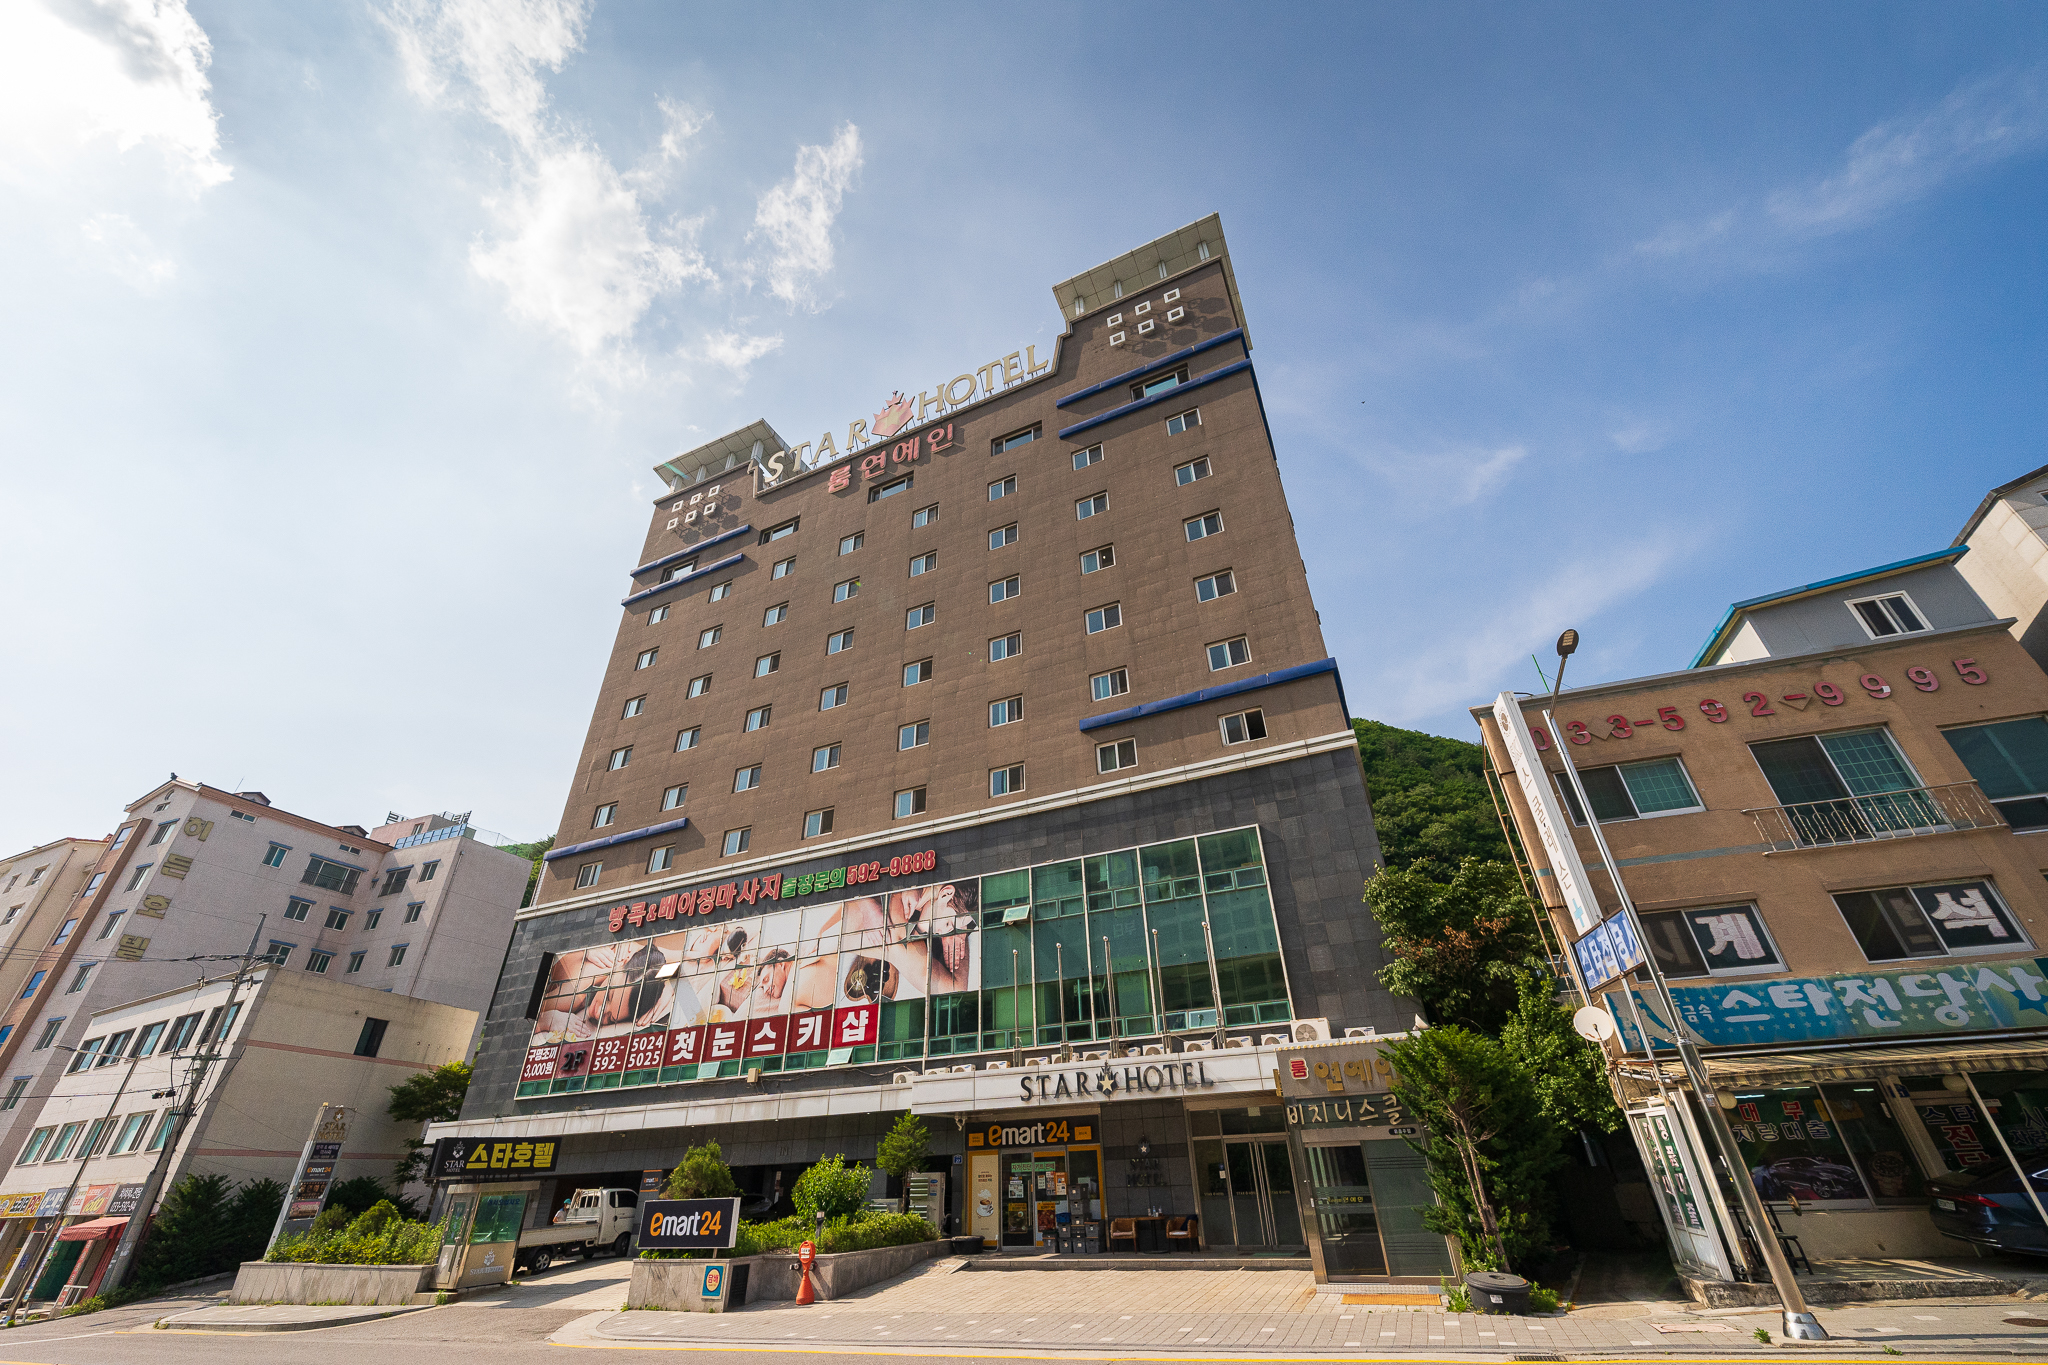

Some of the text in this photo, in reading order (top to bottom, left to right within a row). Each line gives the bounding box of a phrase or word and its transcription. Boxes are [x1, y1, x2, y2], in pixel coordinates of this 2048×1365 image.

[765, 344, 1050, 484] STAR HOTEL
[826, 423, 956, 494] 룸 연예인
[846, 849, 937, 885] 592-9888
[1722, 964, 2044, 1028] 스타전당사
[672, 1009, 870, 1062] 첫눈스키샵
[527, 1045, 558, 1062] 구명조끼
[562, 1050, 586, 1072] 2F
[523, 1060, 555, 1078] 3,000원
[1020, 1061, 1215, 1101] STAR HOTEL
[1290, 1059, 1308, 1079] 룸
[988, 1120, 1070, 1146] emart24
[444, 1160, 465, 1168] STAR
[465, 1142, 556, 1169] 스타호텔
[650, 1210, 722, 1236] emart24
